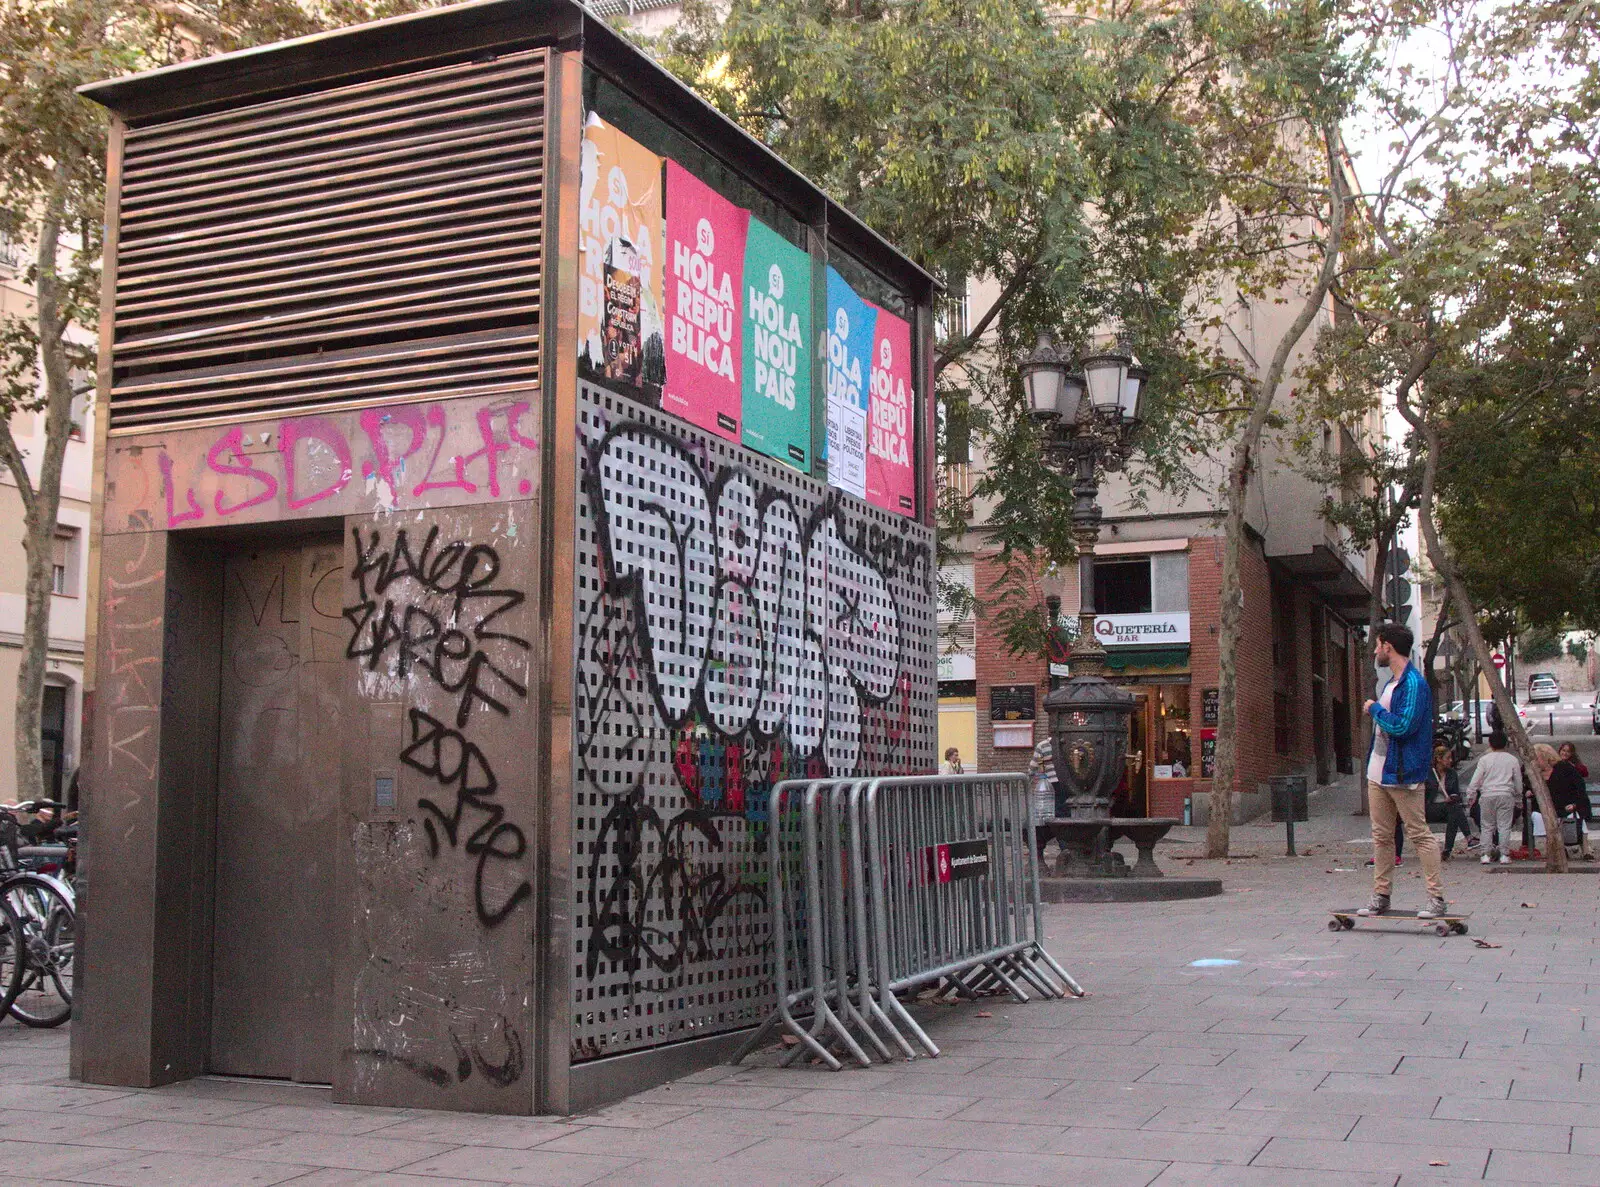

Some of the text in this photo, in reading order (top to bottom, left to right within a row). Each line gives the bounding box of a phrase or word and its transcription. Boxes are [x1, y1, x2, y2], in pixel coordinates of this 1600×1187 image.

[674, 239, 735, 310] HOLA
[749, 285, 803, 348] HOLA
[672, 314, 735, 384] BLICA
[754, 323, 796, 377] NOU
[755, 358, 796, 411] PAÍS
[870, 366, 908, 409] HOLA
[1096, 620, 1177, 635] QUETERÍA
